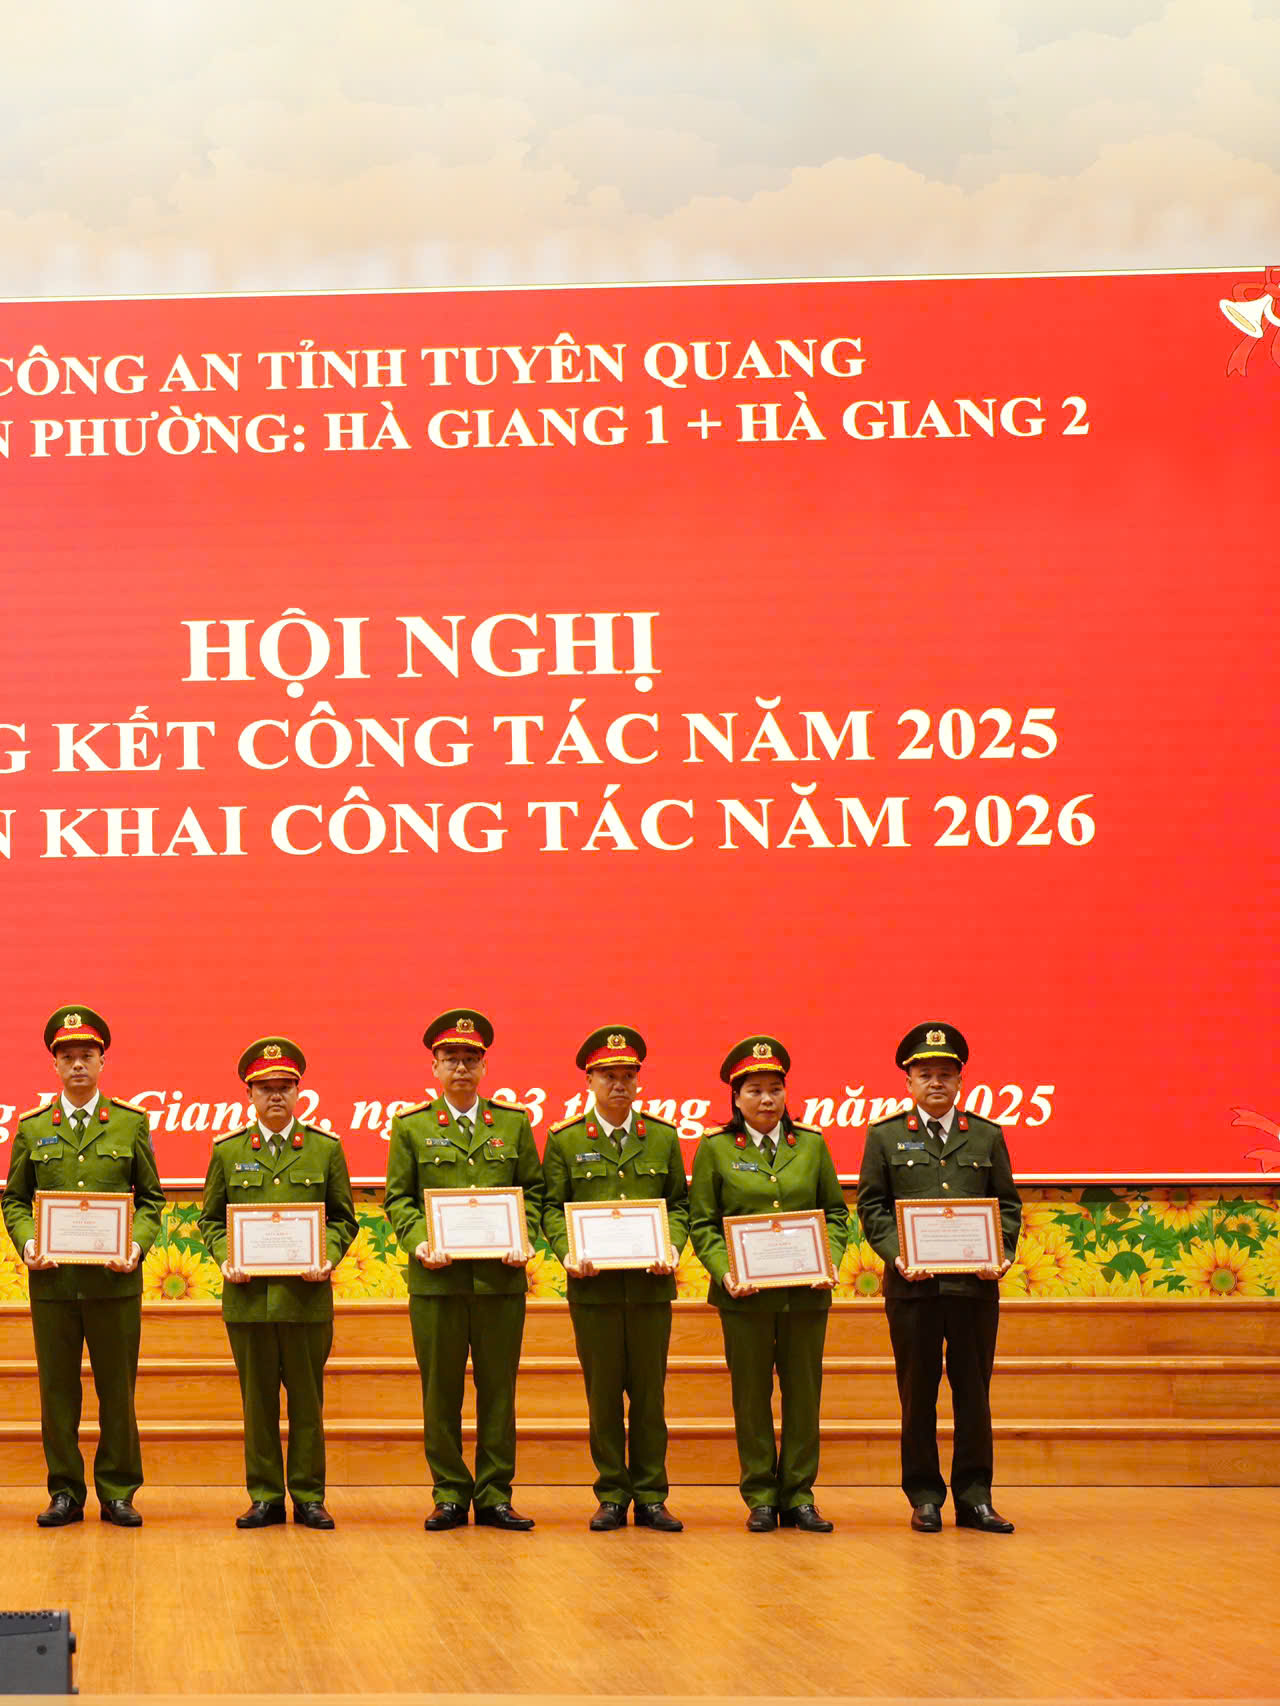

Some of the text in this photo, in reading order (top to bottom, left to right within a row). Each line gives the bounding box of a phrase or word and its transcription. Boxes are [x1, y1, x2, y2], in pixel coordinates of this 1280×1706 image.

[160, 353, 242, 392] AN
[258, 340, 407, 389] TỈNH
[421, 333, 626, 386] TUYÊN
[644, 338, 866, 388] QUANG
[28, 406, 305, 457] PHƯỜNG:
[324, 401, 411, 450] HÀ
[428, 406, 628, 448] GIANG
[645, 406, 668, 443] 1
[688, 409, 721, 439] +
[736, 392, 826, 441] HÀ
[843, 398, 1045, 440] GIANG
[1062, 397, 1089, 434] 2
[181, 608, 661, 698] HỘI NGHỊ
[52, 706, 215, 772] KẾT
[238, 701, 473, 769] CÔNG
[493, 698, 657, 765] TÁC
[682, 695, 874, 763] NĂM
[898, 708, 1057, 759] 2025
[40, 806, 248, 857] KHAI
[271, 786, 507, 855] CÔNG
[528, 784, 693, 851] TÁC
[717, 782, 911, 849] NĂM
[934, 794, 1095, 846] 2026
[954, 1084, 1055, 1127] 025
